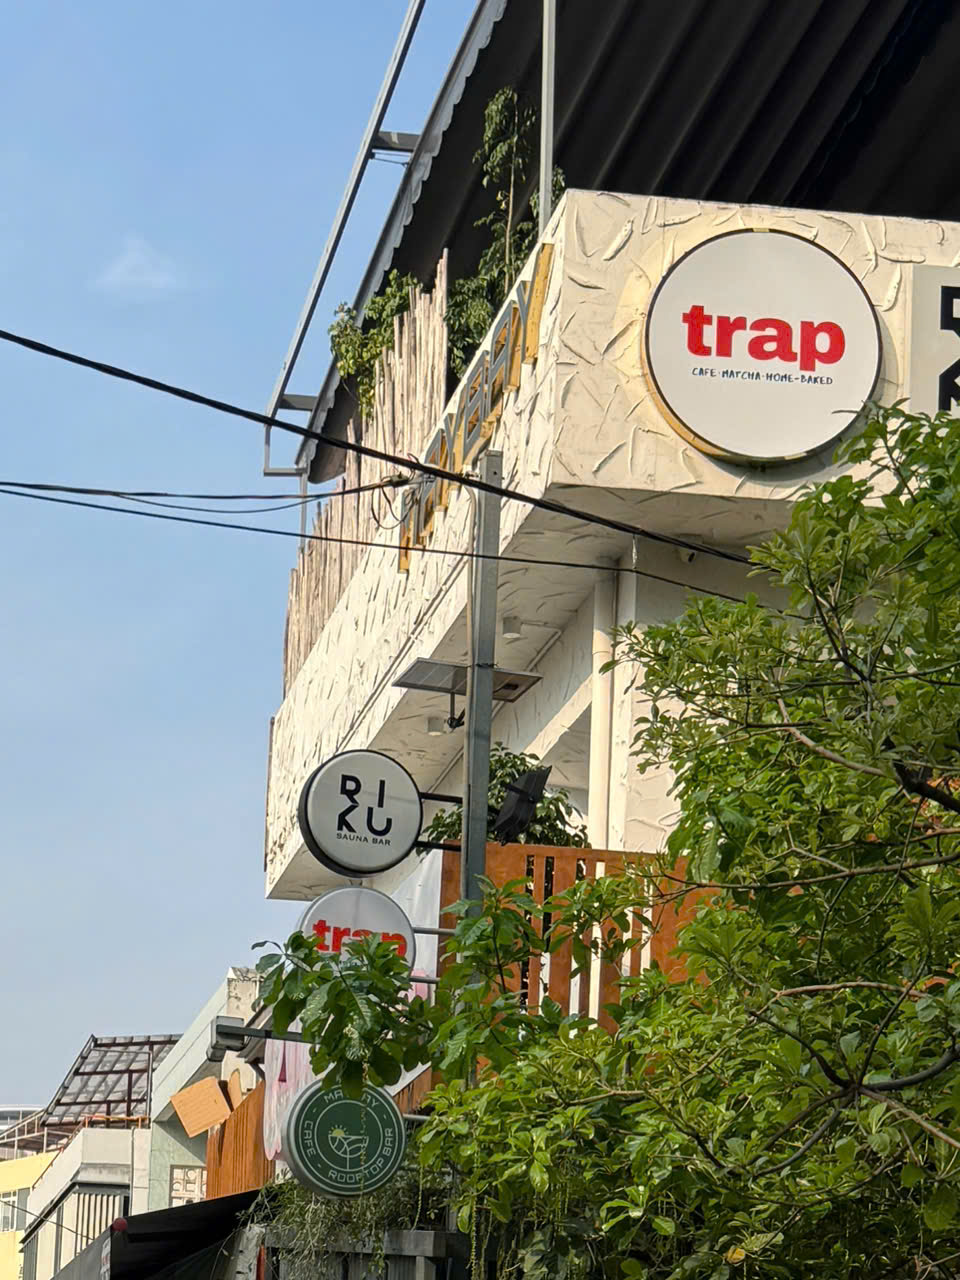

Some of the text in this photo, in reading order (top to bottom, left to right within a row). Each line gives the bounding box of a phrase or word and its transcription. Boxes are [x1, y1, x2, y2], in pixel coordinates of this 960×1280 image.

[682, 304, 846, 372] trap
[692, 367, 717, 377] CAFE
[721, 369, 761, 380] MATCHA
[336, 832, 391, 846] SAUNA BAR
[303, 1120, 317, 1158] CAFE
[328, 1127, 394, 1183] ROOFTOP BAR
